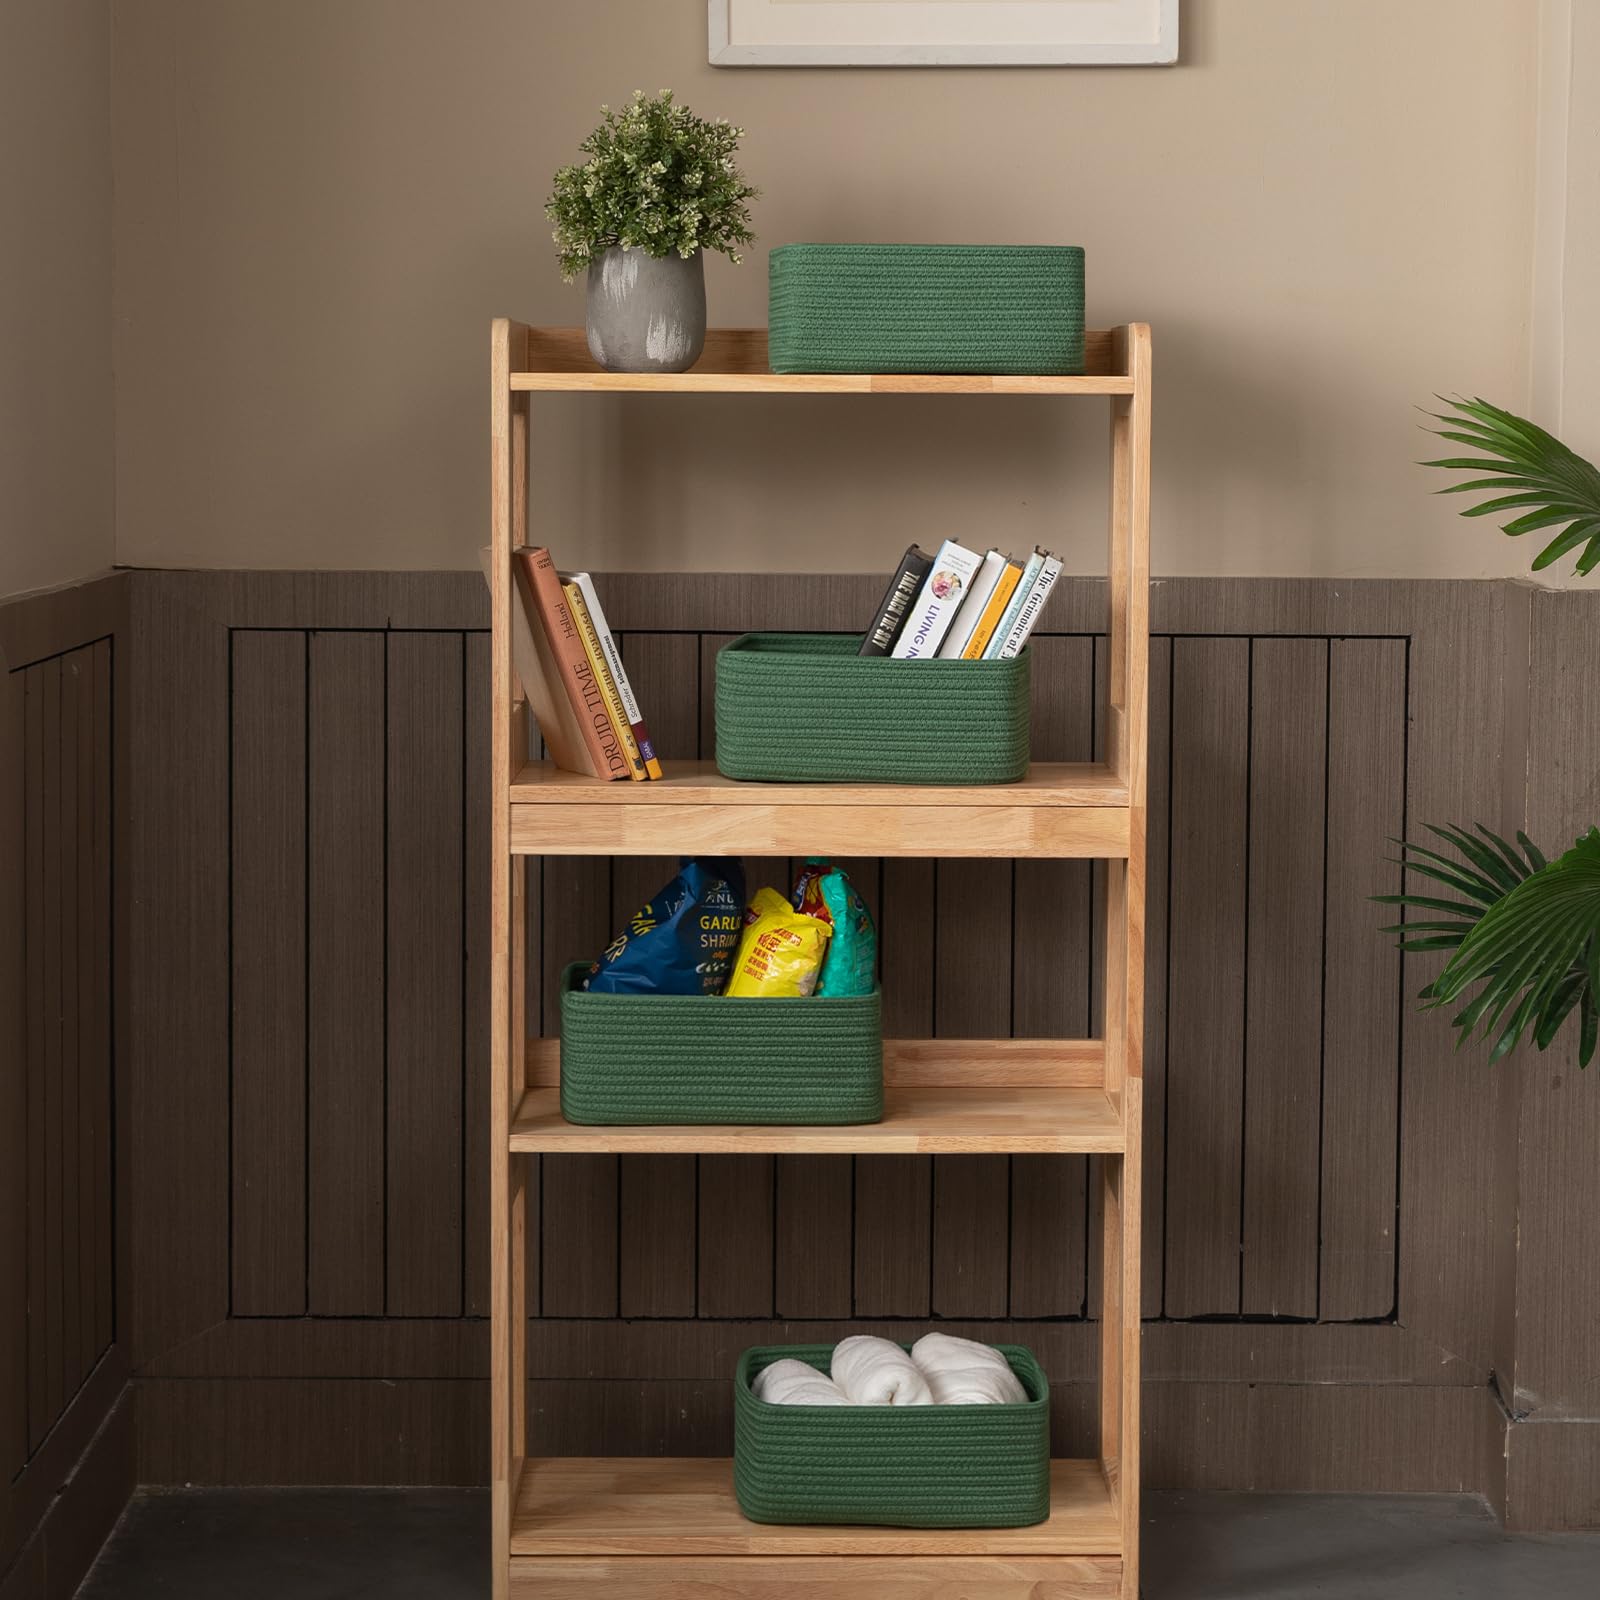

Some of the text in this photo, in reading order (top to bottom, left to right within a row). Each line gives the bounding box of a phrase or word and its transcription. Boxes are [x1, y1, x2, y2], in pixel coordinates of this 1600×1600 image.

[1038, 569, 1057, 591] The
[555, 603, 575, 639] Holland
[871, 569, 921, 650] TAKE BACK THE SKY
[913, 604, 940, 645] LIVING
[1012, 593, 1044, 640] Grimoire
[1006, 639, 1018, 652] of
[580, 611, 628, 728] РУССКАЯ ТВЕРДЫНЯ
[573, 660, 625, 772] DRUID TIME
[621, 687, 638, 718] Schröder
